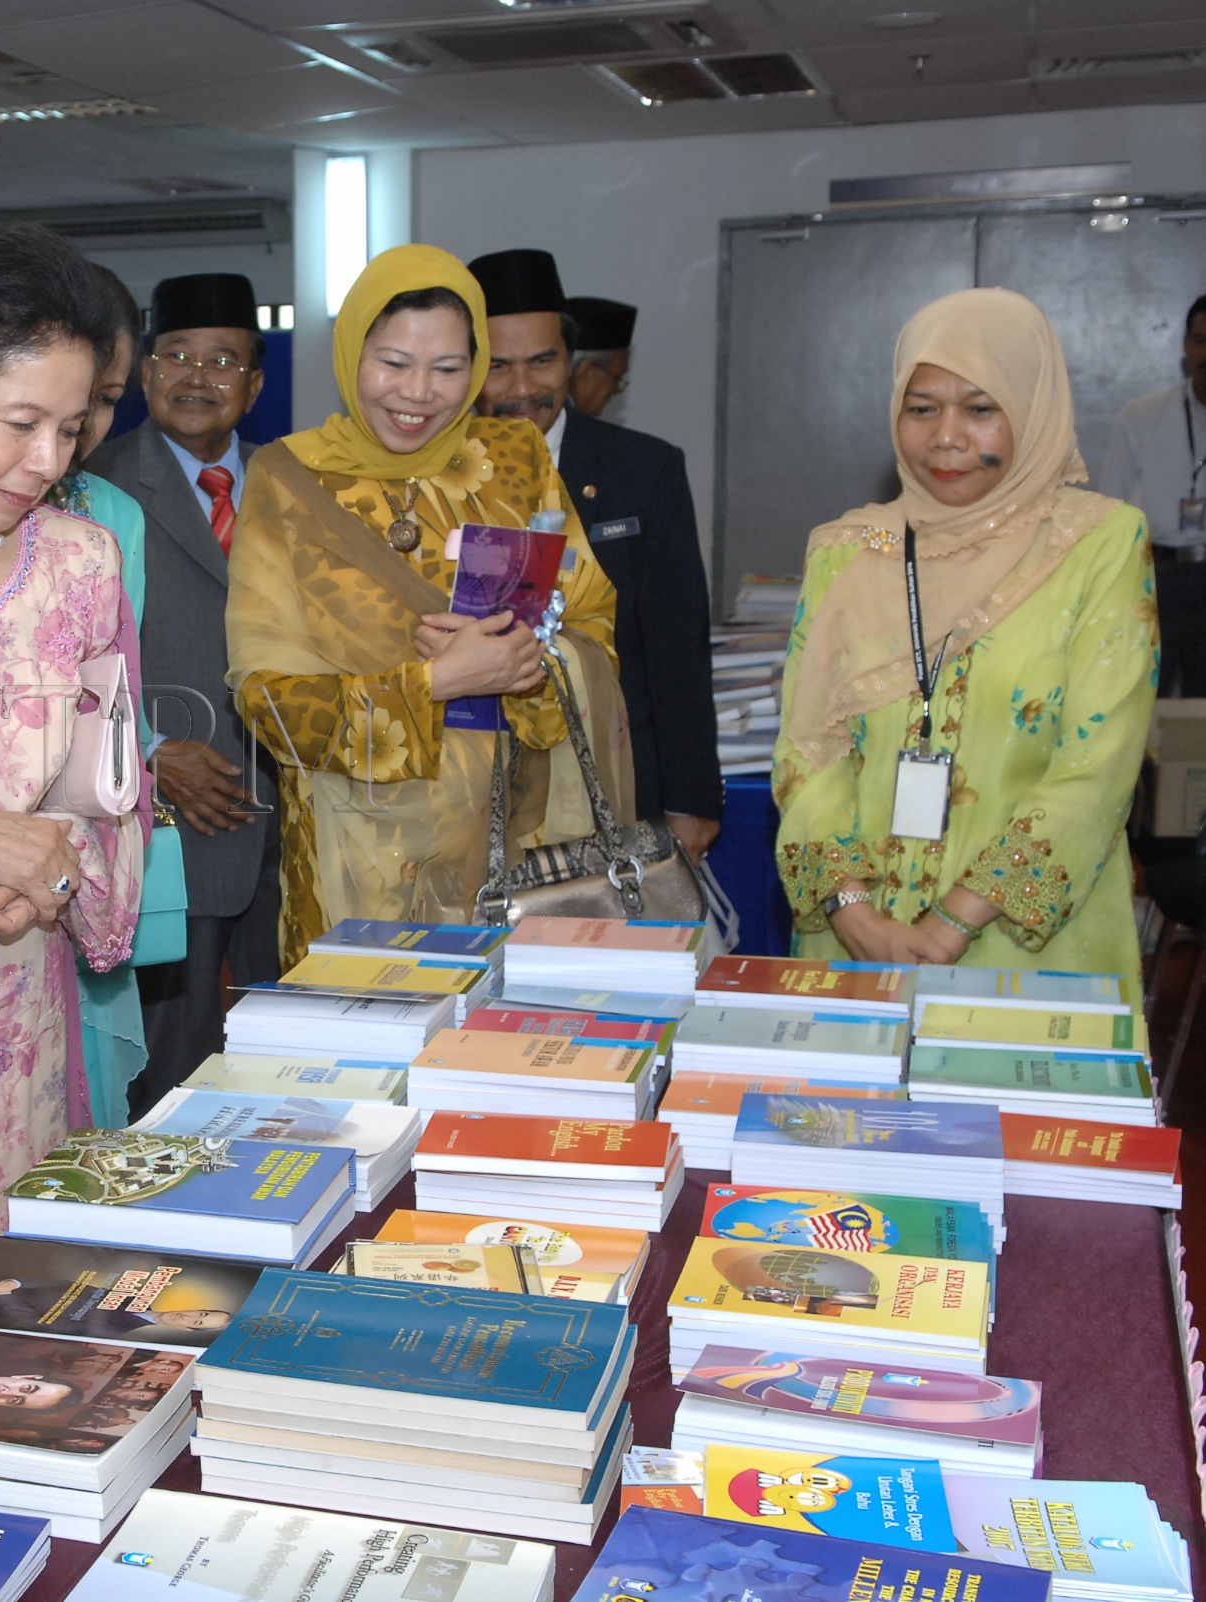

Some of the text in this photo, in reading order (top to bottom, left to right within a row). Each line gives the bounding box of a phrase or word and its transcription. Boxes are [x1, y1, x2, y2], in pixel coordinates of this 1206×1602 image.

[576, 1122, 607, 1136] My
[604, 1122, 634, 1151] Pardon
[96, 1269, 151, 1311] Modal Insan
[124, 1266, 183, 1313] Pembangunan
[891, 1265, 919, 1319] ORGANISASI
[923, 1267, 939, 1283] DAN
[942, 1269, 965, 1309] KERJAYA
[856, 1492, 872, 1509] Bahu
[877, 1476, 900, 1529] Urutan Leher &
[897, 1468, 924, 1541] Tangani Stres Dengan
[982, 1524, 1016, 1551] 2007
[1010, 1497, 1051, 1548] TERBITAN
[1045, 1501, 1096, 1574] KATALOG BUKU
[168, 1536, 210, 1587] THOMAS GEORGE
[199, 1558, 210, 1567] BY
[341, 1529, 397, 1602] High Performanc
[384, 1534, 429, 1574] Creating
[303, 1556, 332, 1593] Facilitator's
[878, 1585, 895, 1600] THE
[904, 1569, 921, 1584] THE
[921, 1588, 936, 1597] IN
[962, 1574, 982, 1602] TRANSF
